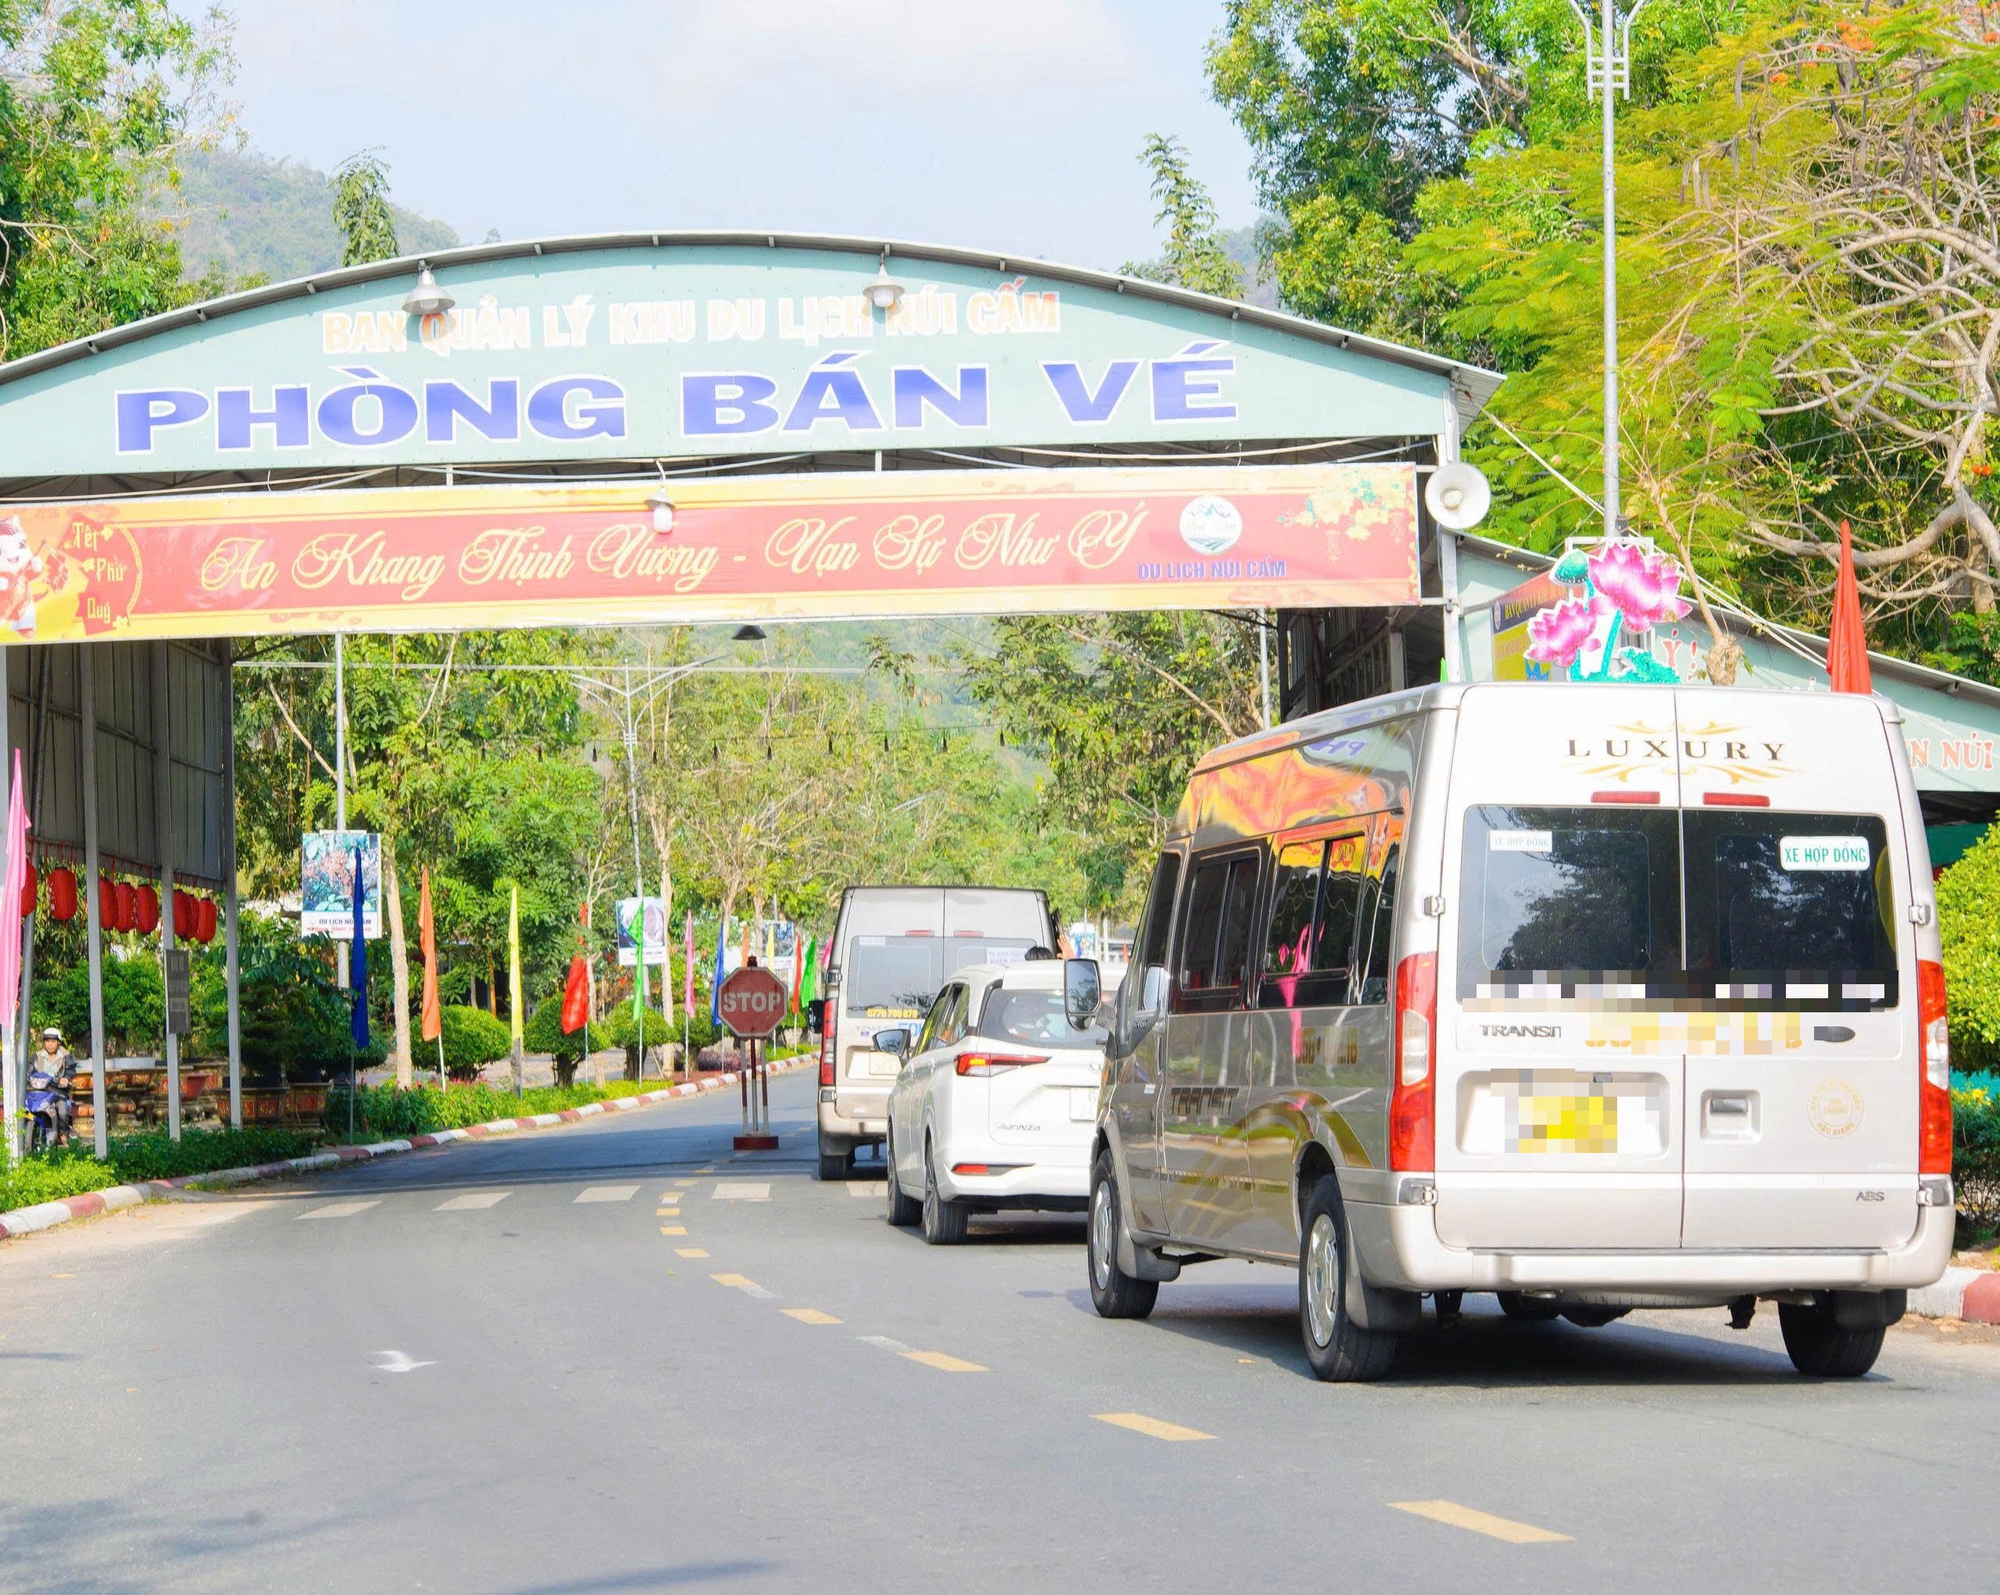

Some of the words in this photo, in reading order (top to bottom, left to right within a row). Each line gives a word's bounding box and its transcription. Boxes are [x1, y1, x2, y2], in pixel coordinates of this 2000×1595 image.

[322, 311, 407, 354] BAN
[419, 294, 532, 358] QUẢN
[543, 294, 596, 348] LÝ
[609, 299, 697, 345] KHU
[707, 297, 766, 342] DU
[778, 295, 874, 347] LỊCH
[885, 284, 958, 335] NÚI
[966, 276, 1061, 335] CẤM
[114, 365, 628, 455] PHÒNG
[680, 350, 990, 437] BÁN
[1037, 341, 1238, 427] VÉ
[201, 536, 278, 591] An
[291, 531, 446, 602] Khang
[458, 526, 575, 586] Thịnh
[586, 523, 720, 593] Vượng
[765, 516, 861, 578] Vạn
[873, 514, 947, 576] Sự
[954, 512, 1061, 570] Như
[1067, 500, 1150, 570] Ý
[1138, 562, 1162, 579] DU
[1167, 562, 1206, 582] LỊCH
[1211, 559, 1241, 578] NÚI
[1246, 554, 1287, 578] CẤM
[1566, 739, 1786, 761] LUXURY
[1904, 738, 1931, 768] N
[1785, 848, 1799, 863] XE
[1804, 845, 1829, 867] HỢP
[723, 992, 781, 1013] STOP
[1855, 1191, 1885, 1202] ABS
